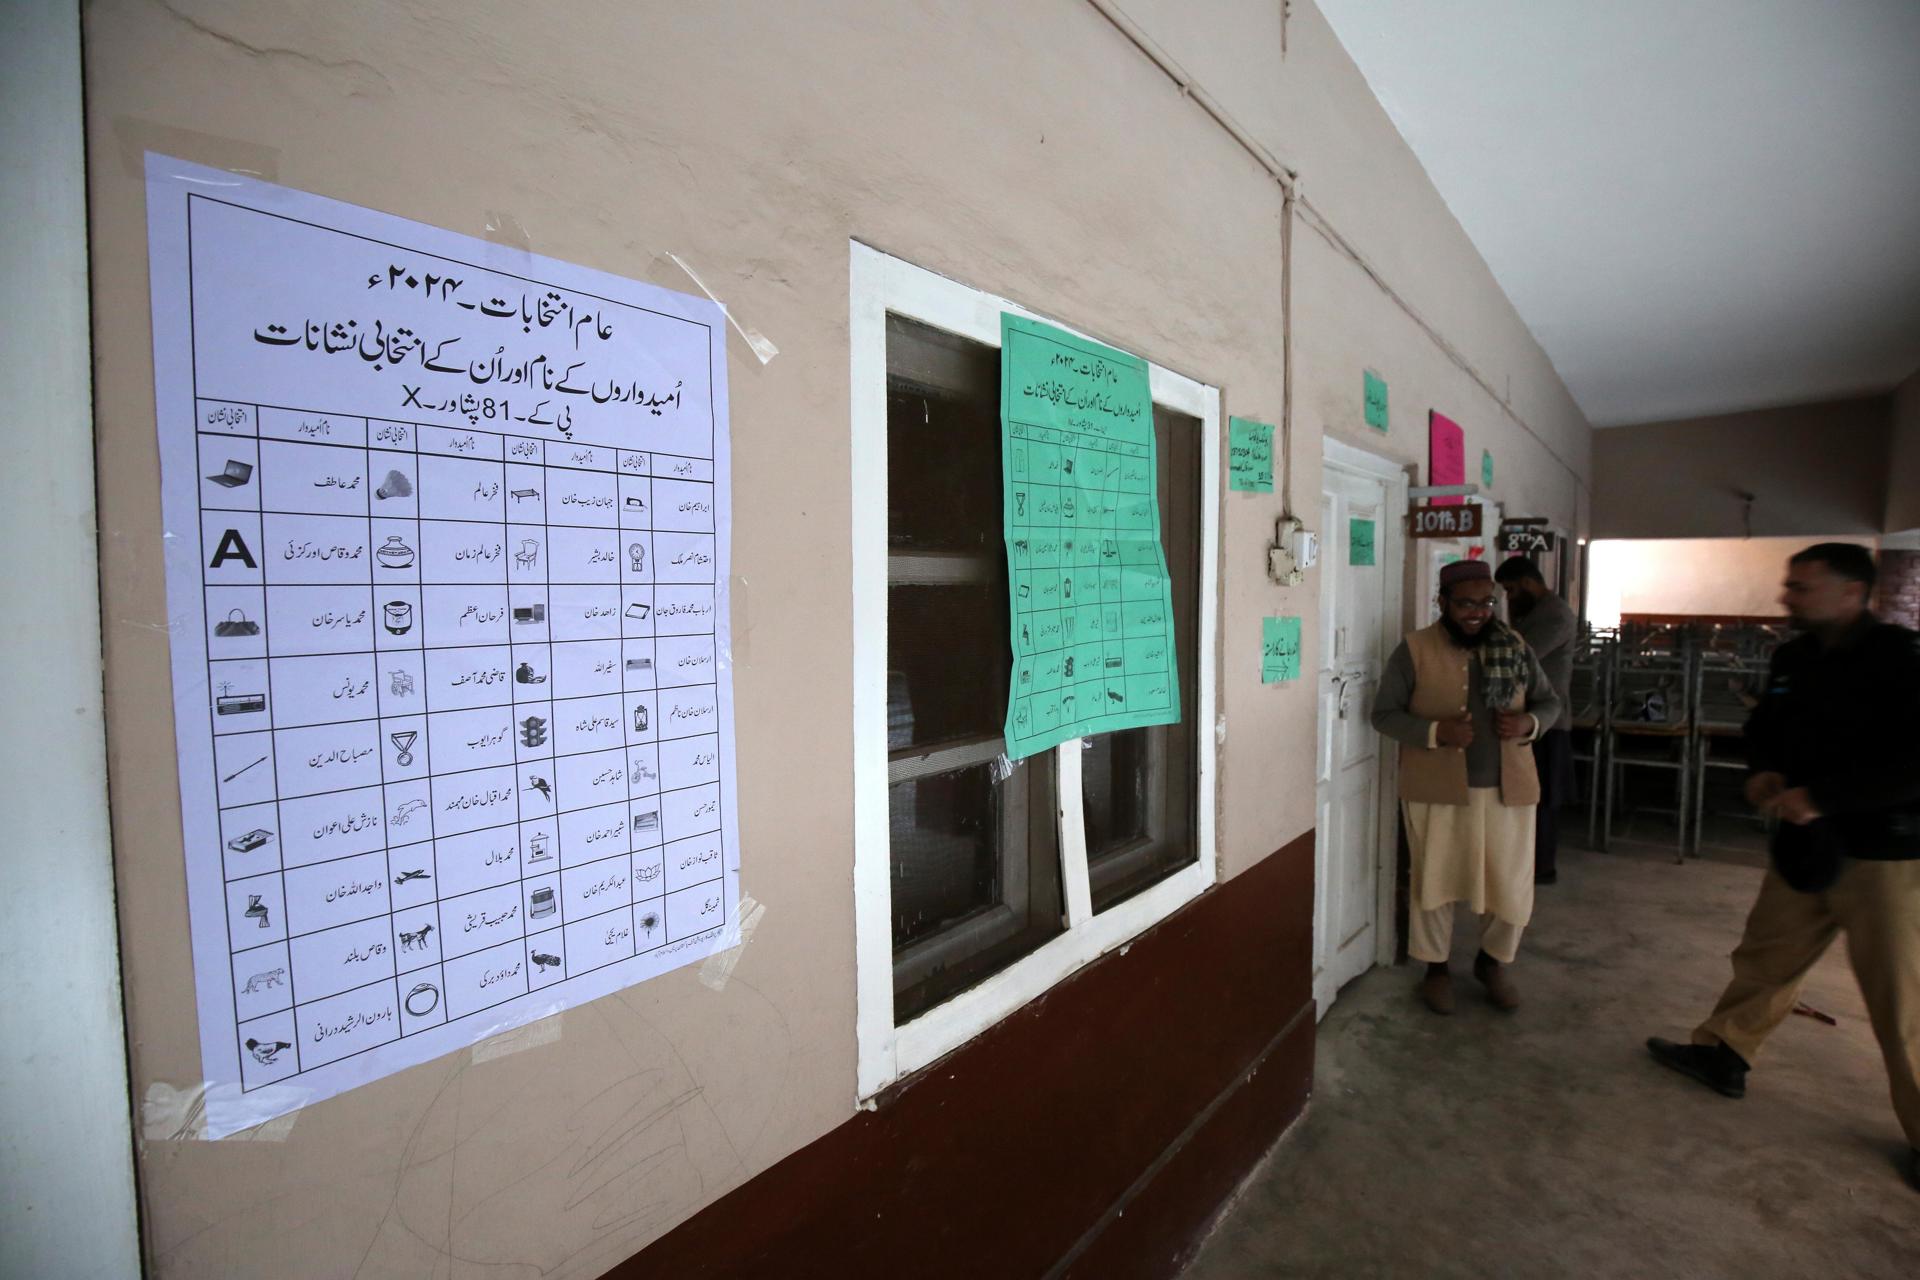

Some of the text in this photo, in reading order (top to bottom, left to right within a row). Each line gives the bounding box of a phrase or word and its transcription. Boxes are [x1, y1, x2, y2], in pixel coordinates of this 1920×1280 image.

[254, 318, 357, 355] نشانات
[575, 311, 613, 350] عام
[359, 319, 426, 371] انتخابی
[424, 337, 467, 373] کے
[501, 360, 529, 385] اور
[530, 354, 554, 391] نام
[555, 361, 590, 395] کے
[207, 408, 247, 430] انتخابی نشان
[557, 405, 573, 440] پی
[376, 426, 408, 446] انتخابی نشان
[511, 441, 538, 459] انتخابی نشان
[623, 455, 645, 471] انتخابی نشان
[314, 475, 360, 489] محمد عاطف
[474, 481, 499, 501] فخر عالم
[562, 493, 578, 505] خان
[679, 501, 710, 516] ابراہیم خان
[1458, 509, 1473, 532] B
[209, 529, 258, 569] A
[1530, 534, 1549, 551] A
[321, 546, 350, 560] وقاص
[350, 546, 362, 560] محمد
[455, 544, 501, 564] فخر عالم زمان
[588, 548, 614, 564] خالد بشیر
[460, 605, 503, 627] فرحان اعظم
[585, 606, 599, 618] خان
[656, 606, 668, 616] جان
[669, 603, 687, 615] فاروق
[692, 605, 712, 616] ارباب
[312, 610, 366, 629] محمد یاسر خان
[604, 660, 616, 675] سفیر
[679, 655, 711, 667] ارسلان خان
[451, 668, 505, 686] قاضی محمد آصف
[333, 678, 369, 698] محمد یونس
[670, 704, 713, 724] ارسلان خان ناظم
[576, 715, 619, 734] سید قاسم علی شاہ
[467, 727, 508, 749] گوہر ایوب
[309, 747, 373, 768] مصباح الدین
[699, 752, 714, 765] الیاس
[592, 768, 622, 785] شاہد حسین
[446, 788, 512, 810] محمد اقبال خان مہمند
[694, 801, 715, 817] تیمور حسن
[313, 812, 377, 839] نازش علی اعوان
[586, 820, 624, 843] شبیر احمد خان
[485, 847, 514, 866] محمد بلال
[680, 849, 718, 869] ثاقب نواز خان
[326, 881, 382, 903] واجد اللہ خان
[583, 884, 598, 898] خان
[464, 911, 486, 932] قریشی
[507, 905, 517, 920] محمد
[616, 928, 628, 944] غلام
[360, 943, 387, 962] وقاص
[511, 962, 520, 976] محمد
[314, 1007, 392, 1042] ہارون الرشید درانی
